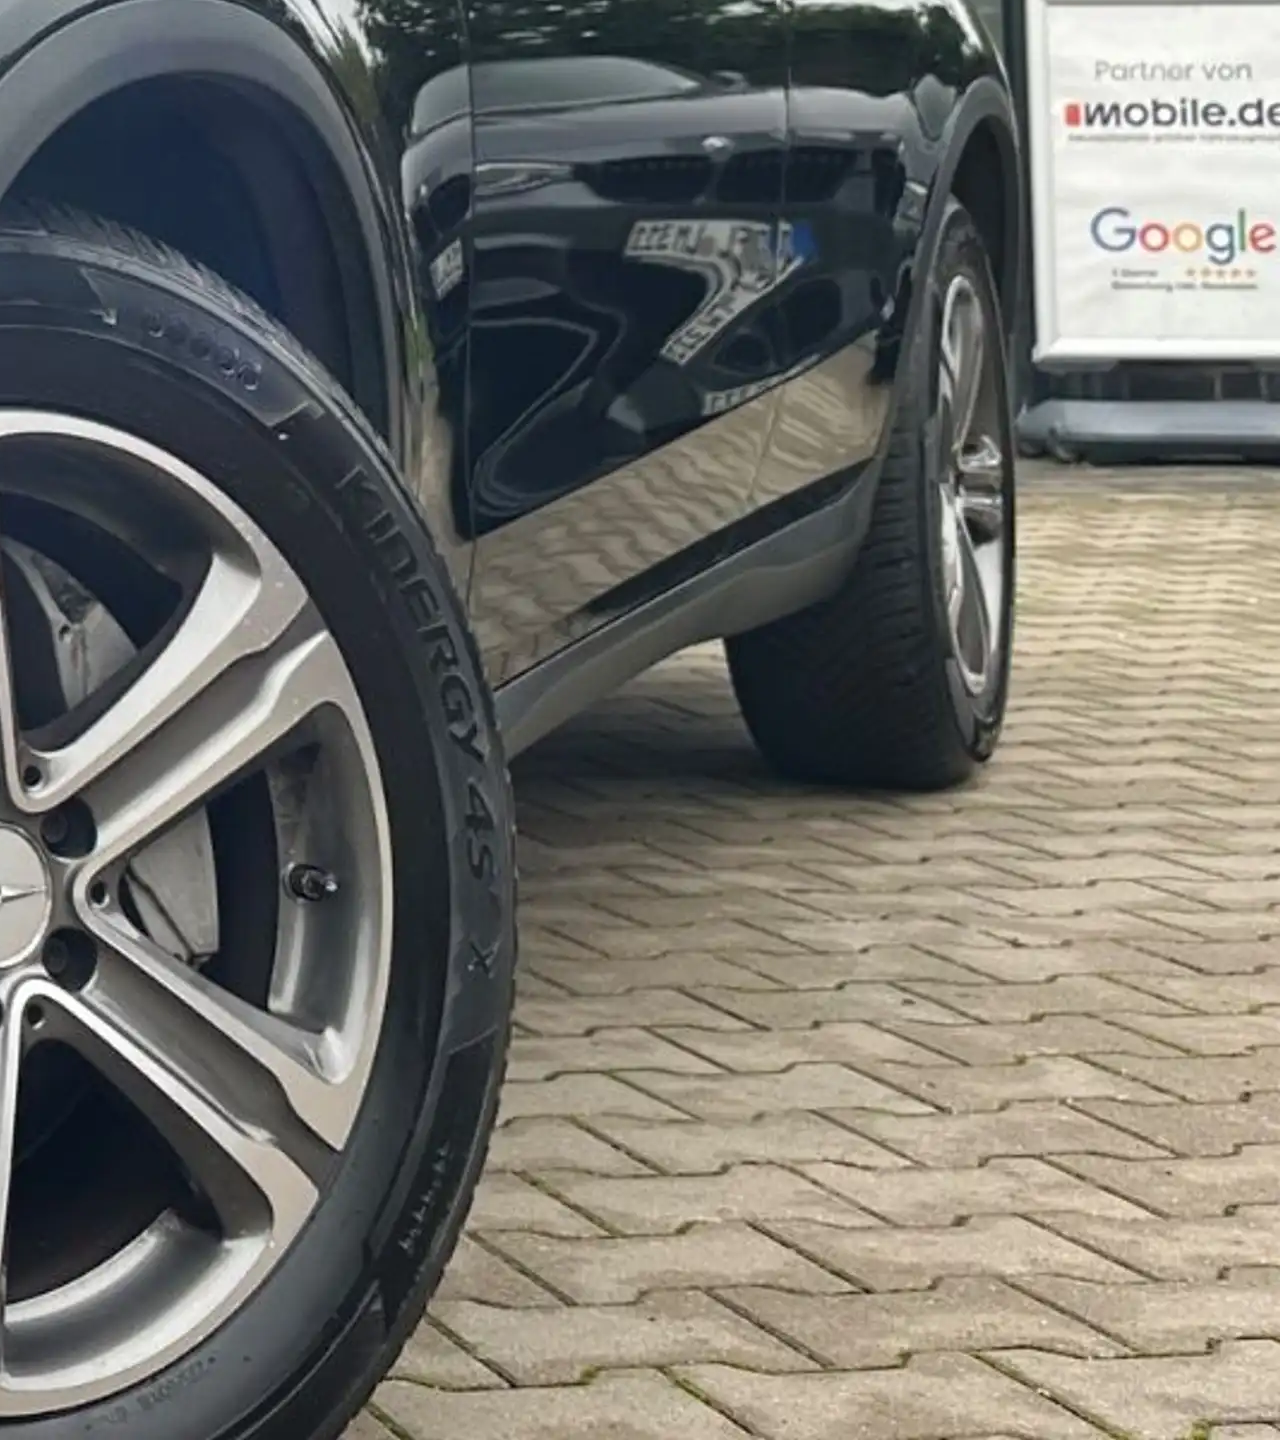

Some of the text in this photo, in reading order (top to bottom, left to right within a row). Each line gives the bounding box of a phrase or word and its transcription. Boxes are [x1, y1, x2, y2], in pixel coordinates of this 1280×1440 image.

[1095, 59, 1253, 82] Partner von
[1090, 206, 1277, 266] Google
